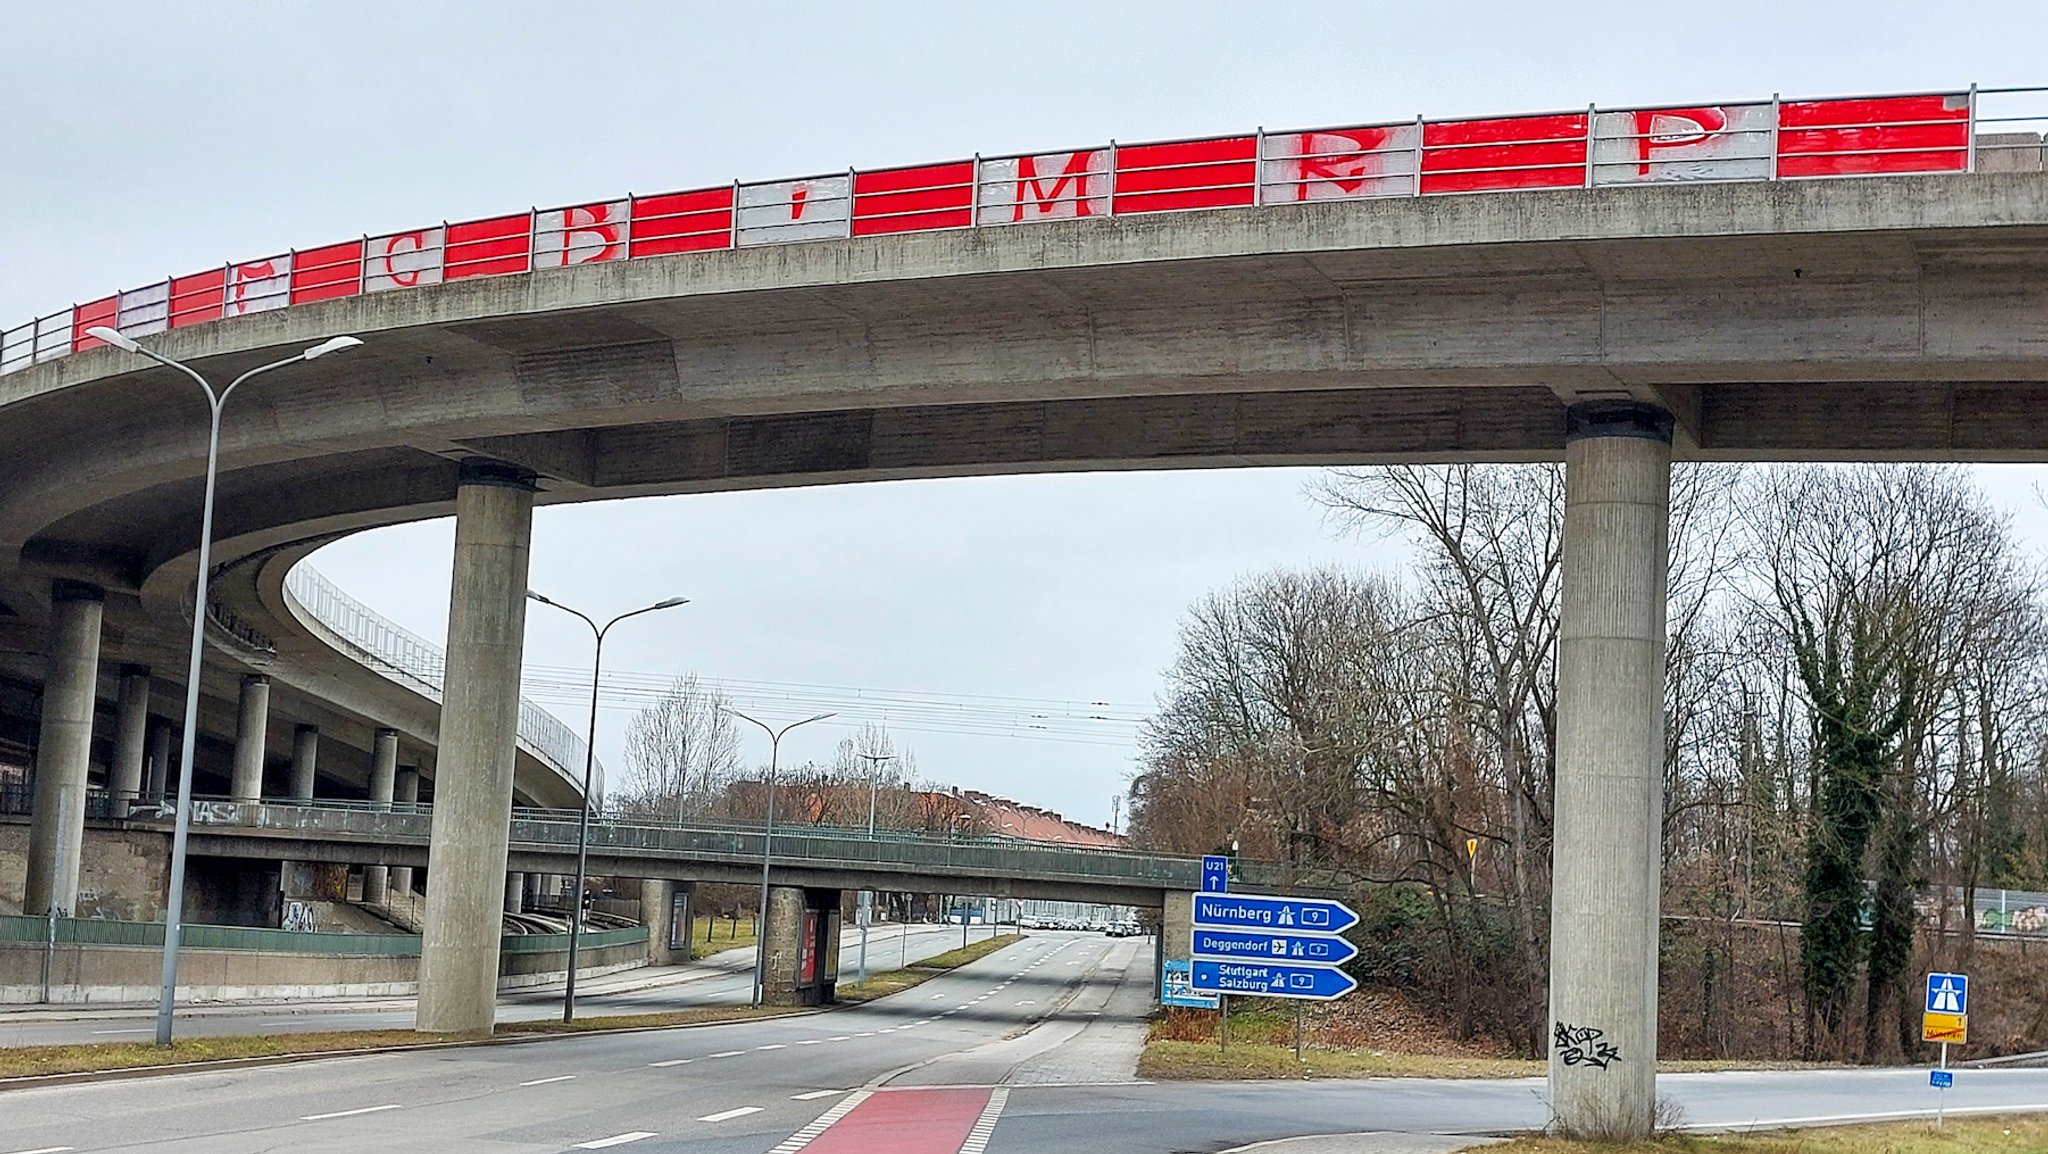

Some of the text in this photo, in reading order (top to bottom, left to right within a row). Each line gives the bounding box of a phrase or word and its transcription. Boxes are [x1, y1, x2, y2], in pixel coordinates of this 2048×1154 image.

[561, 203, 620, 267] B
[1012, 151, 1092, 222] M
[1297, 126, 1388, 201] R
[1632, 105, 1728, 176] P
[1206, 860, 1225, 871] U21
[1201, 903, 1319, 924] Nürnberg 9
[1202, 937, 1322, 954] Deggendorf 9
[1218, 964, 1305, 986] Stuttgart 9
[1218, 977, 1269, 993] Salzburg
[1926, 1028, 1963, 1040] Mcen
